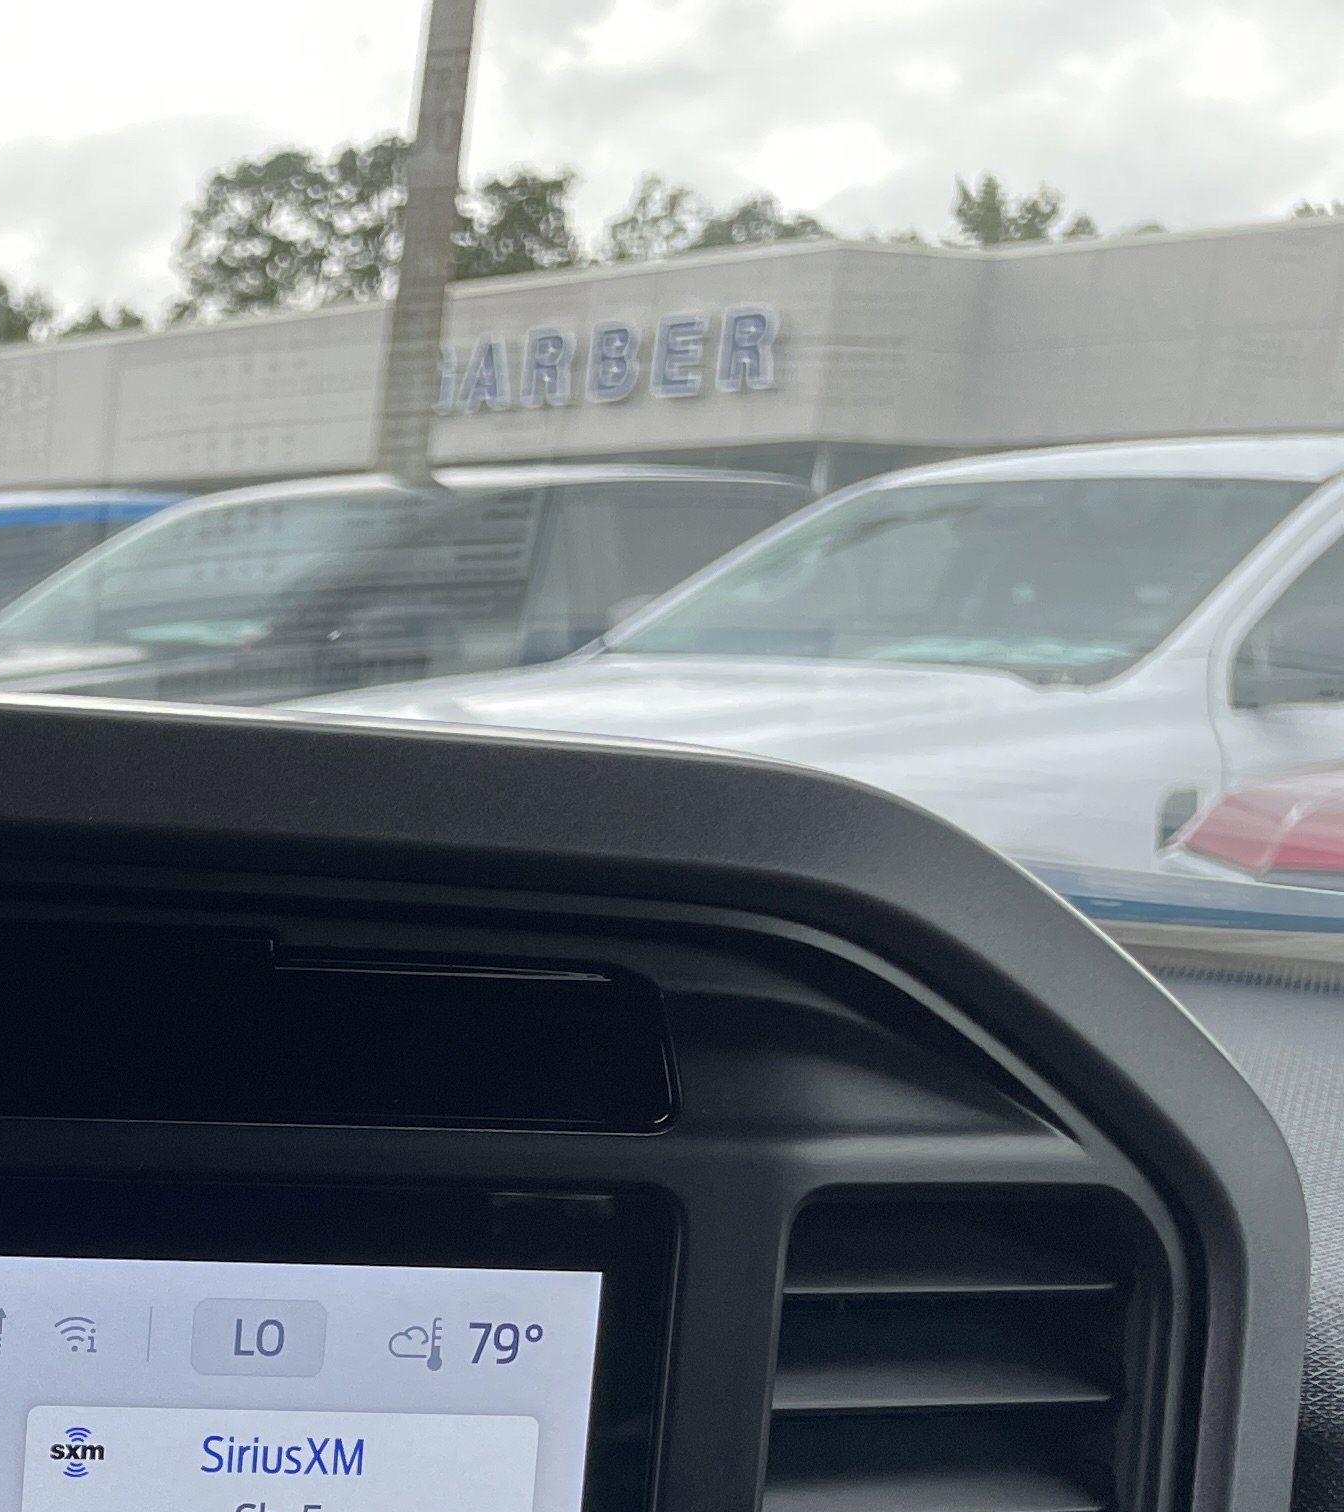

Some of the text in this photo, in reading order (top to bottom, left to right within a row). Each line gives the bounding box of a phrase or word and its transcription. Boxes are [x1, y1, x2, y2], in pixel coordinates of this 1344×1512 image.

[233, 1318, 286, 1358] LO
[468, 1321, 544, 1365] 79°
[50, 1441, 105, 1461] sxm
[200, 1435, 365, 1476] SiriusXM
